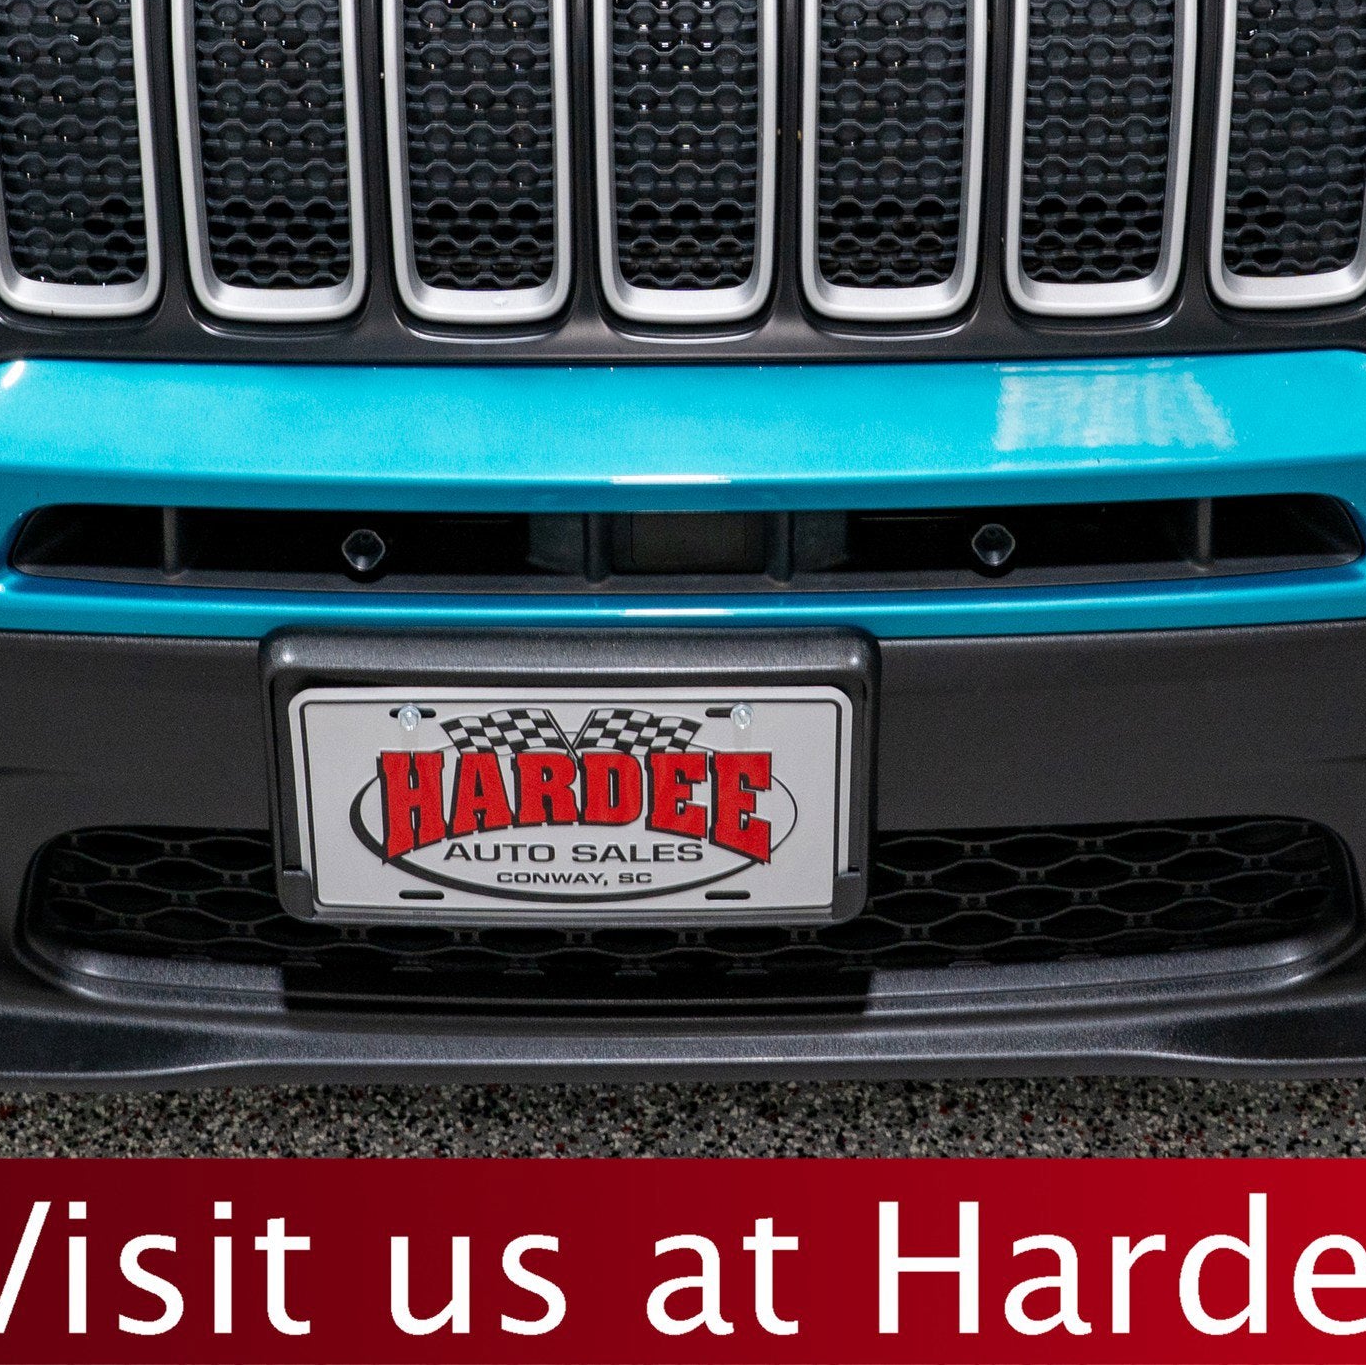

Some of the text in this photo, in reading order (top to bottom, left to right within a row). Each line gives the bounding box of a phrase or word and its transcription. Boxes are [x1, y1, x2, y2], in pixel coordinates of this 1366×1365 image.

[378, 751, 772, 865] HARDEE
[443, 842, 704, 863] AUTO SALES
[496, 872, 653, 886] CONWAY, SC
